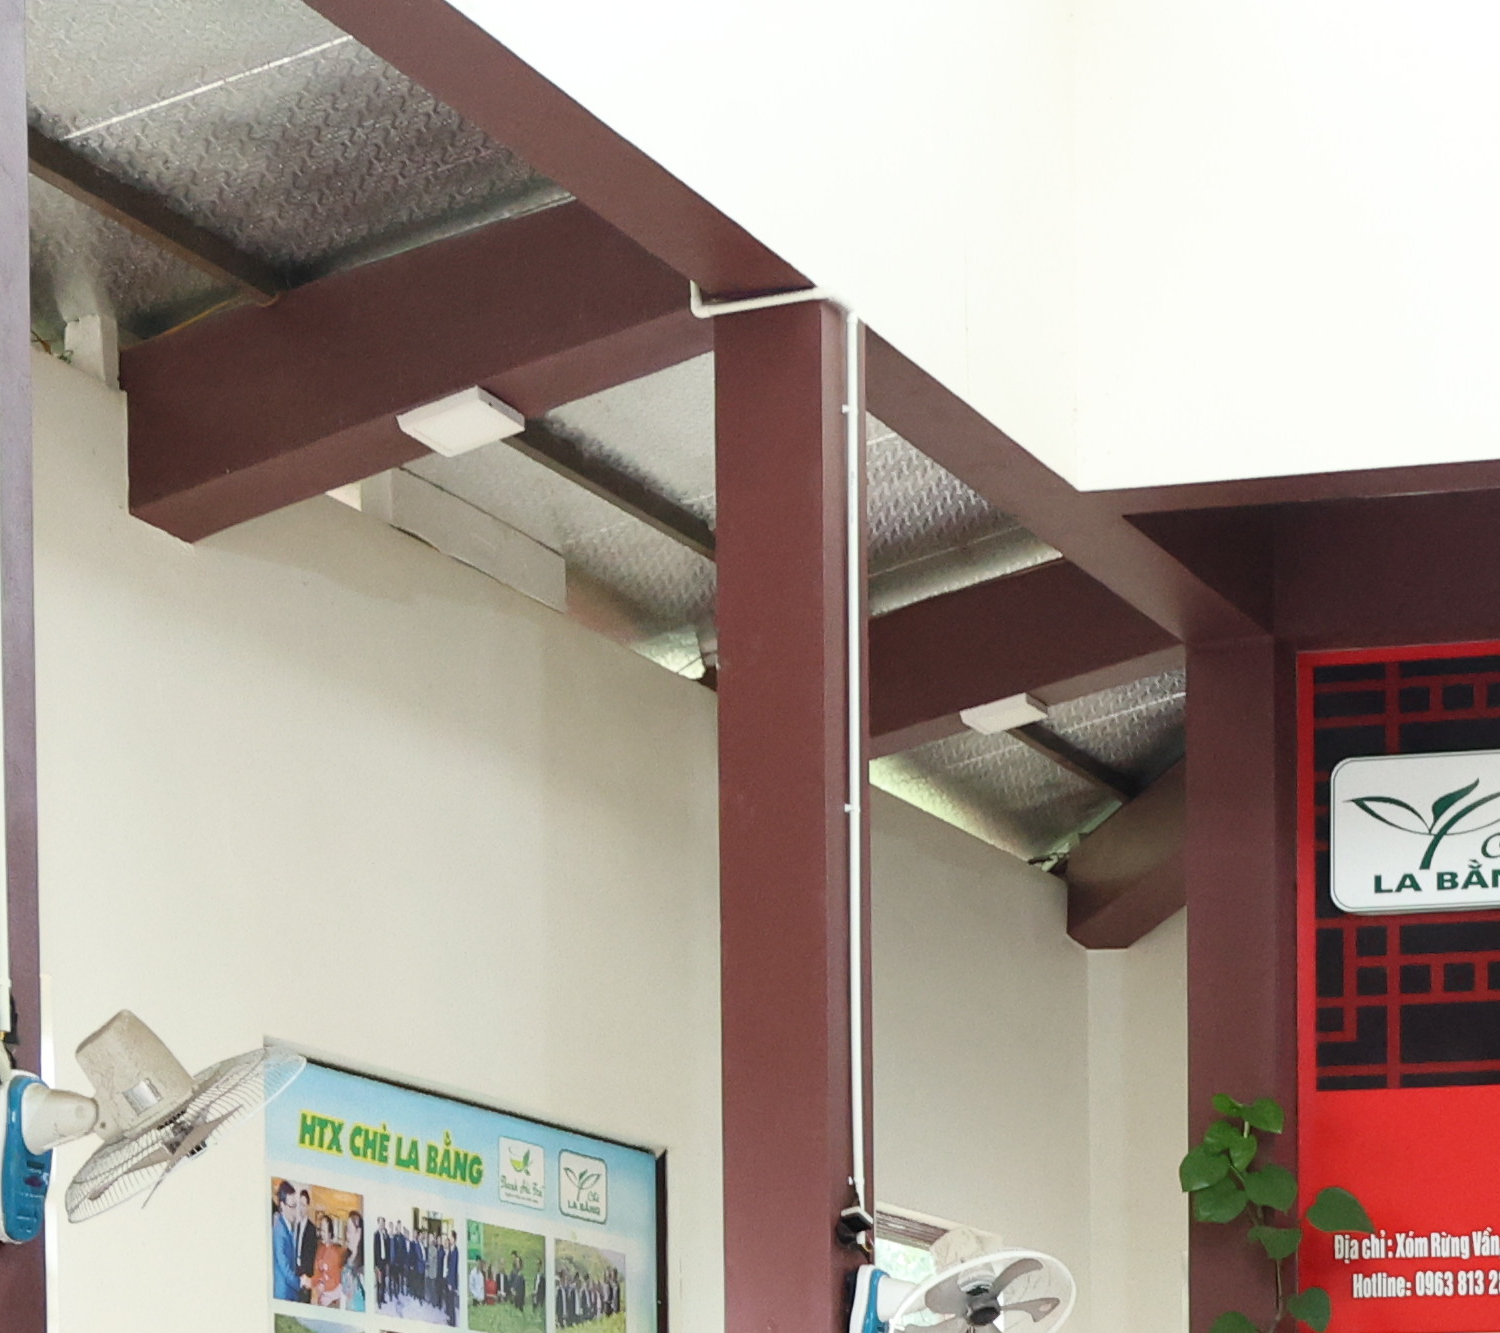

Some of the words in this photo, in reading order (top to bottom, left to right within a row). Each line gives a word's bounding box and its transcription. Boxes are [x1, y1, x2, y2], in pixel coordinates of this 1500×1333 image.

[1373, 873, 1422, 893] LA
[299, 1110, 345, 1154] HTX
[350, 1122, 391, 1165] CHÈ
[395, 1135, 420, 1172] LA
[426, 1130, 484, 1188] BẰNG
[1334, 1234, 1359, 1264] Địa
[1395, 1231, 1429, 1259] Xóm
[1431, 1231, 1470, 1260] Rừng
[1352, 1272, 1411, 1298] Hotline:
[1415, 1270, 1454, 1297] 0963
[1457, 1269, 1485, 1296] 813
